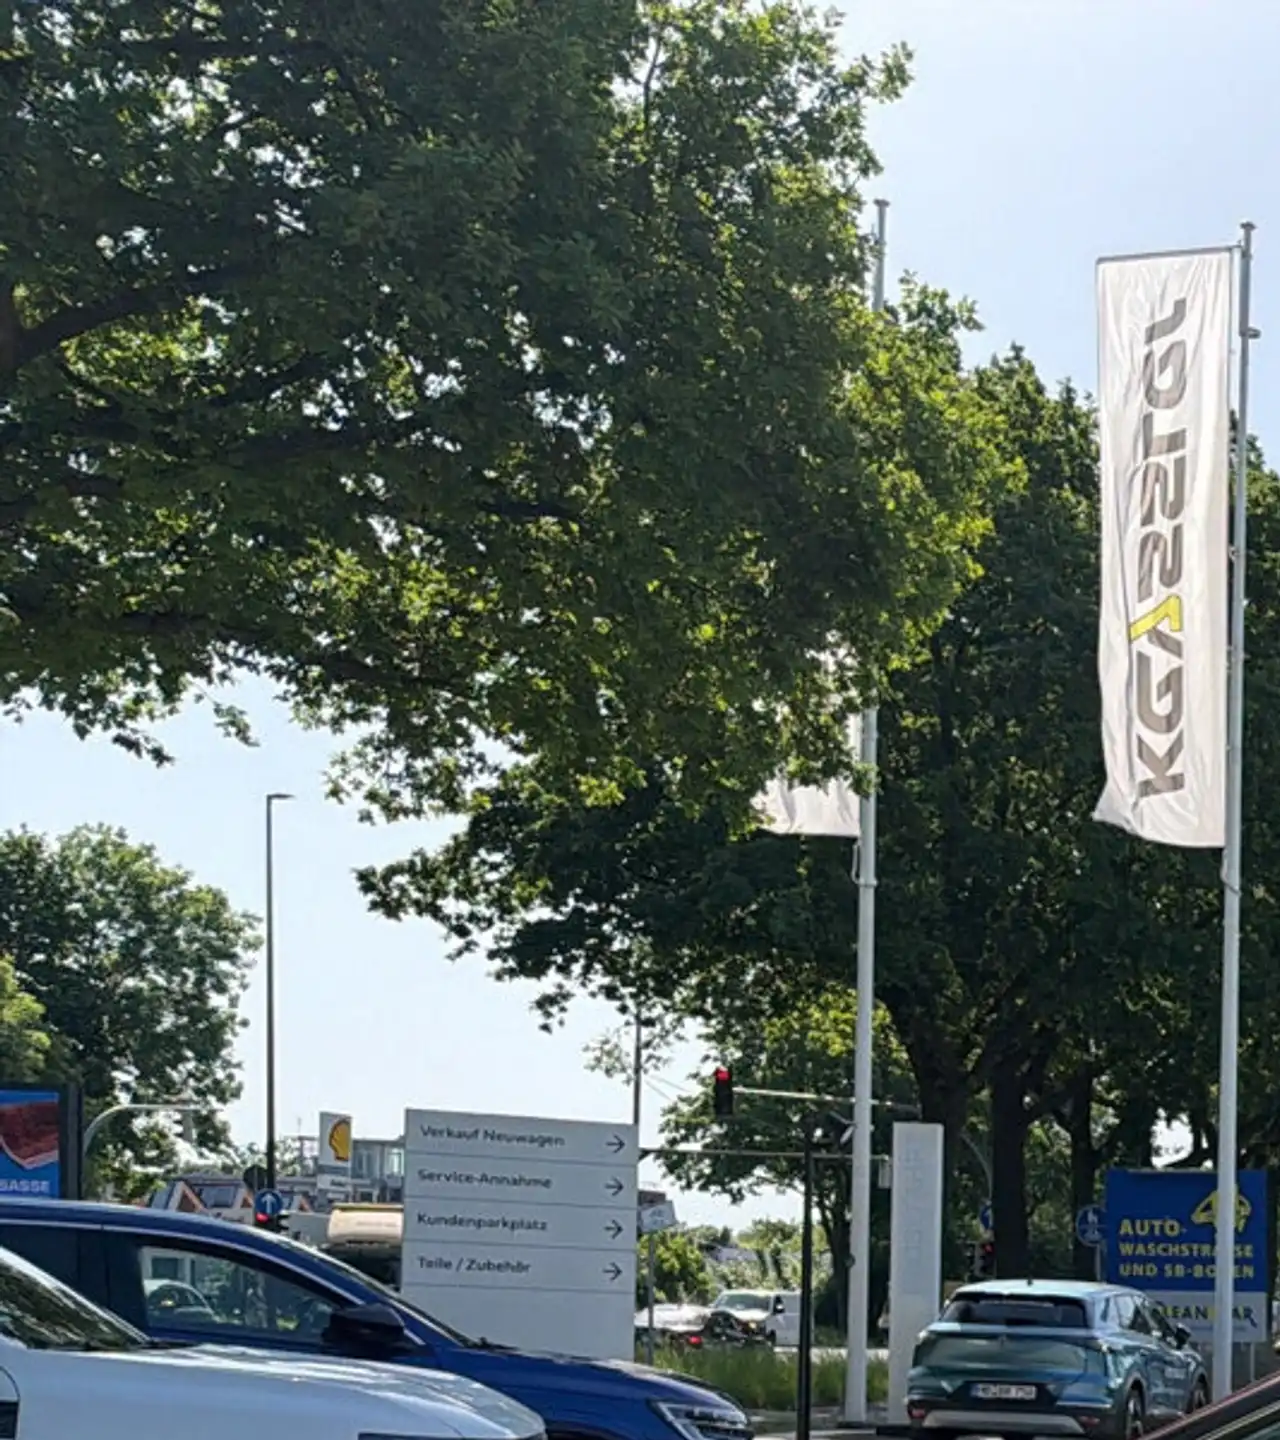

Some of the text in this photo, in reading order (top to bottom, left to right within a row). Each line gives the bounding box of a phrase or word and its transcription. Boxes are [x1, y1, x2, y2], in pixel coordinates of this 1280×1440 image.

[420, 1124, 566, 1148] Verkauf Neuwagen
[418, 1169, 552, 1188] Service-Annahme
[417, 1212, 548, 1231] Kundenparkplatz
[1119, 1218, 1187, 1237] AUTO-
[418, 1255, 453, 1269] Teile
[465, 1258, 531, 1273] Zubehör
[1119, 1263, 1254, 1278] UND SB-BOEN
